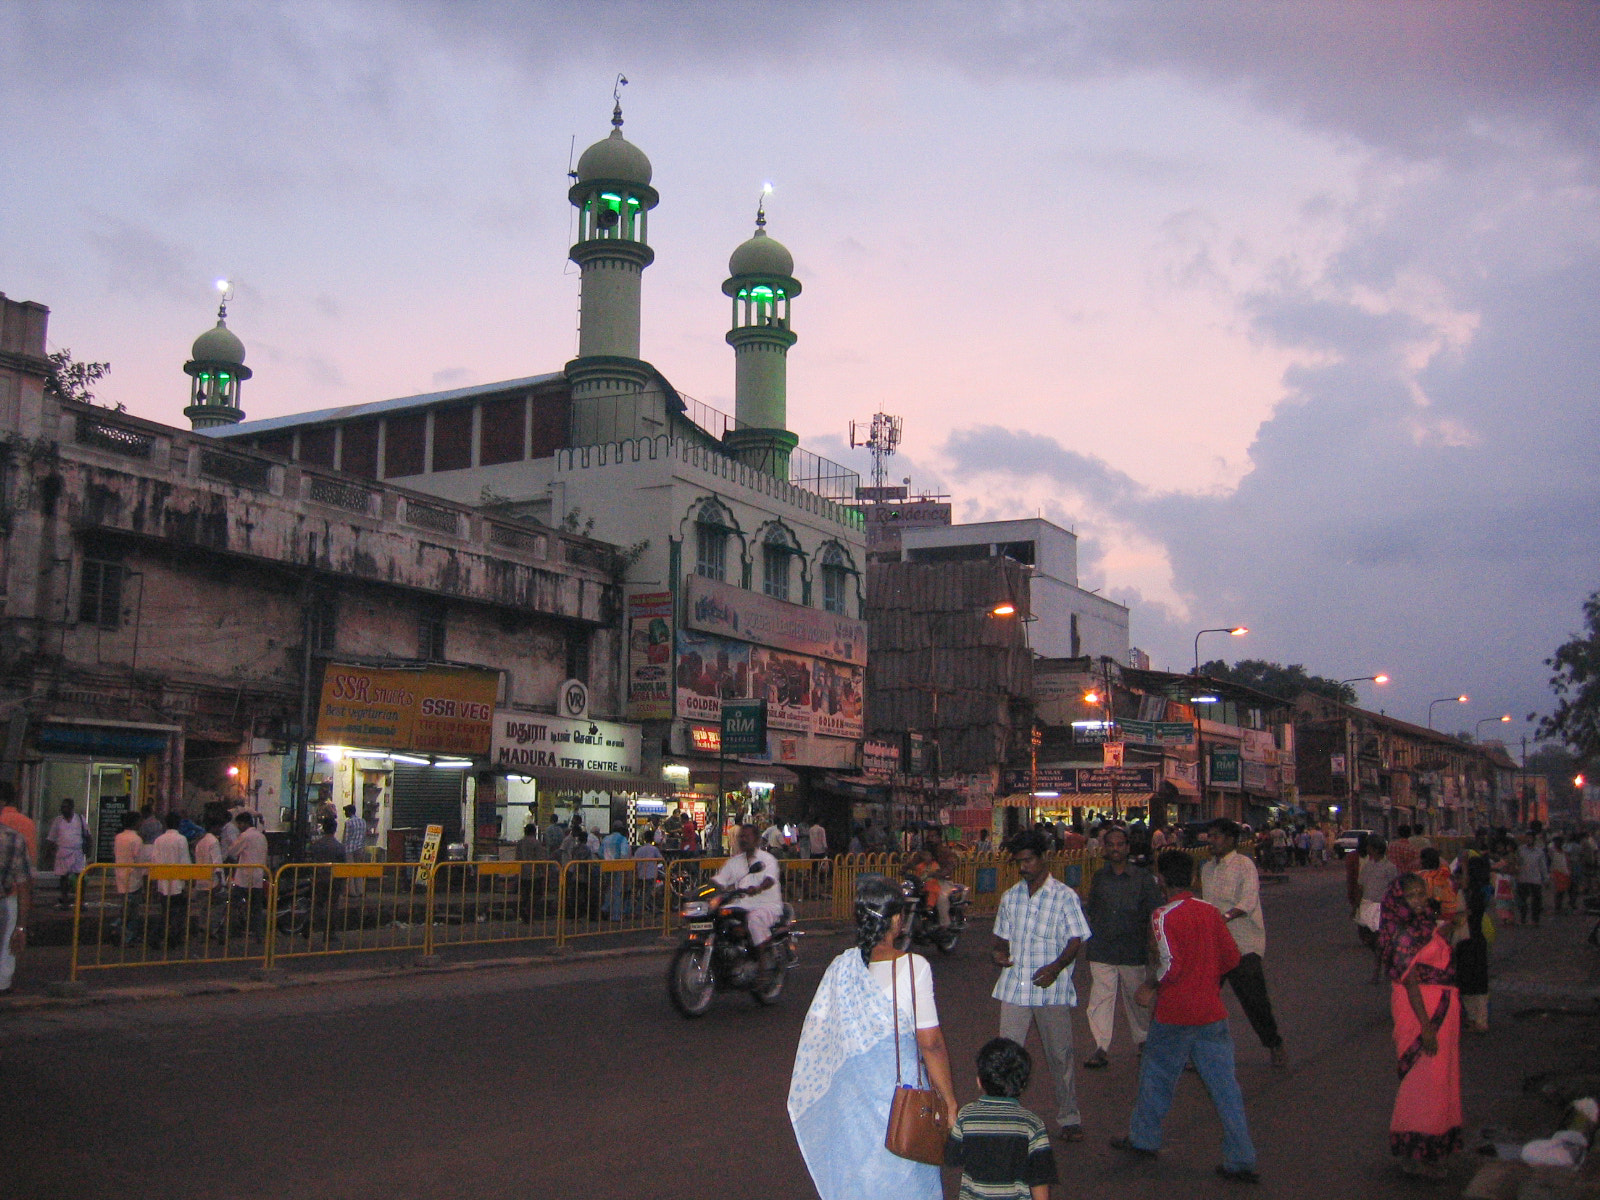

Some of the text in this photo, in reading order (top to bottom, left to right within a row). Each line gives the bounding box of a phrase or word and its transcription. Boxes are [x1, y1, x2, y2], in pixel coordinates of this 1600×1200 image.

[857, 487, 904, 499] HOTEL
[333, 675, 371, 704] SSR
[422, 698, 490, 721] SSR VEG
[687, 697, 719, 712] GOLDEN
[727, 719, 755, 732] RIM
[819, 716, 844, 728] GOLDEN
[500, 747, 556, 767] MADURA
[560, 757, 584, 769] TIFFIN
[587, 760, 618, 772] CENTRE
